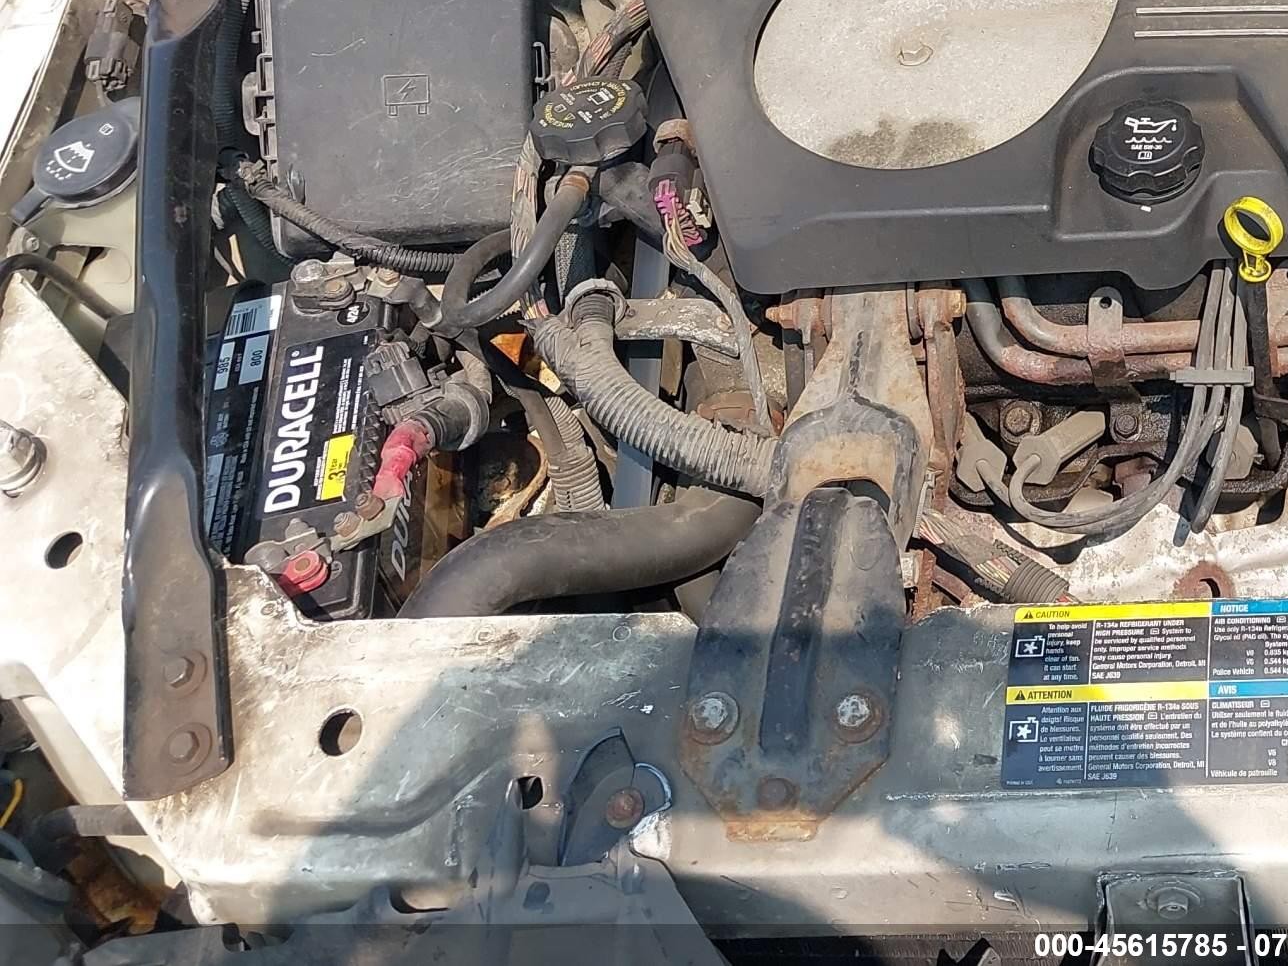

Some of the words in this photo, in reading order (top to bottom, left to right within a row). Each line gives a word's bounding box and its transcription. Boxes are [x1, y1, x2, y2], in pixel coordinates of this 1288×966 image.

[250, 349, 263, 367] 800
[217, 356, 230, 374] 985
[264, 346, 325, 513] DURACELL
[1220, 604, 1248, 613] NOTICE
[1036, 610, 1069, 619] CAUTION
[1265, 640, 1288, 648] System
[1218, 686, 1236, 694] AVIS
[1028, 690, 1072, 700] ATTENTION
